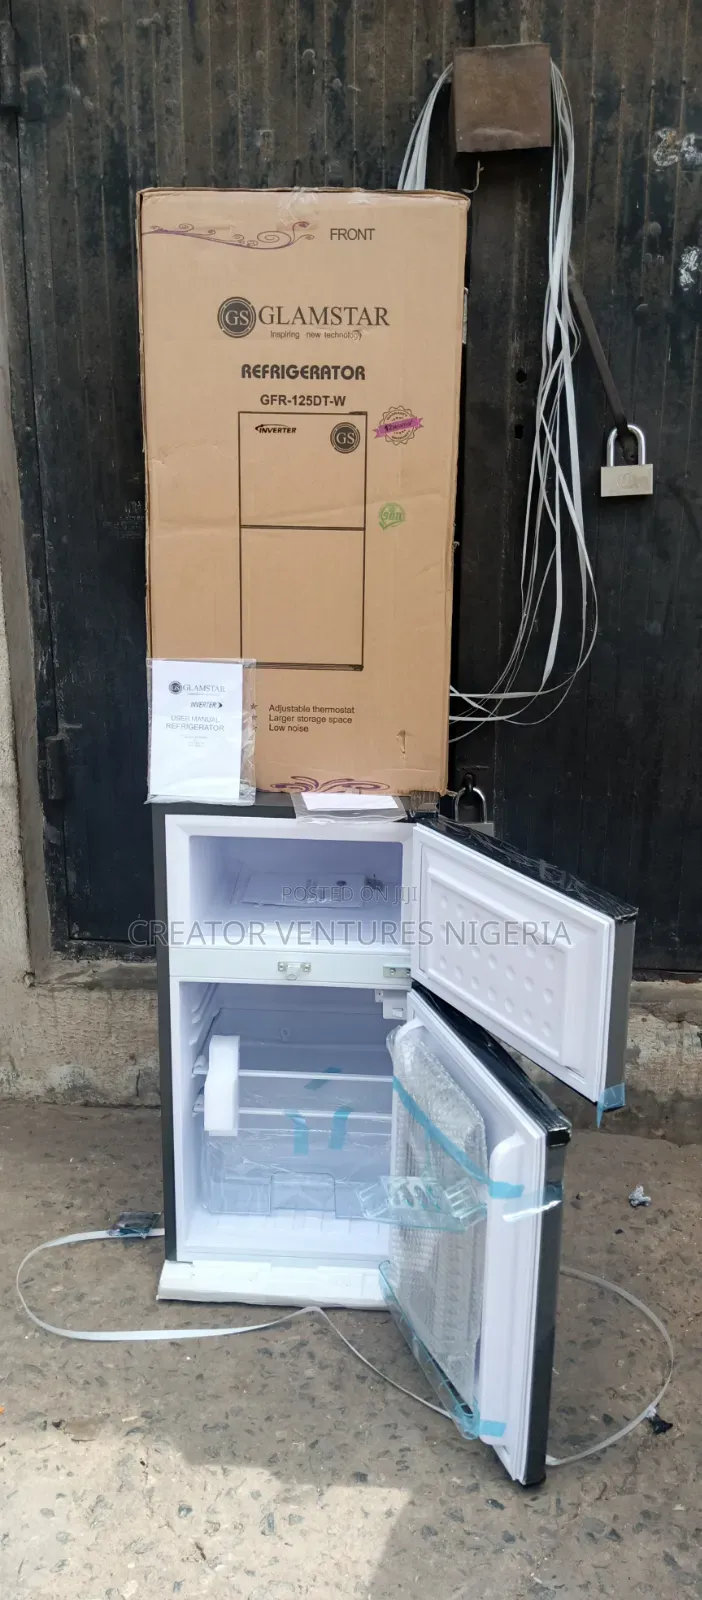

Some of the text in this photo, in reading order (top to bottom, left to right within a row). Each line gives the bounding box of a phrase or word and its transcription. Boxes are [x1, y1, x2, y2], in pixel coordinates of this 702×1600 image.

[330, 228, 375, 241] FRONT
[225, 305, 390, 326] GS GLAMSTAR
[270, 330, 300, 340] Inspiring
[241, 364, 366, 381] REFRIGERATOR
[260, 394, 346, 407] GFR-125DT-W
[257, 426, 297, 434] INVERTER
[335, 430, 356, 445] GS
[182, 684, 226, 693] GLAMSTAR
[190, 701, 217, 709] INVERTER
[269, 704, 355, 714] Adjustable thermostat
[269, 714, 353, 725] Larger storage space
[165, 723, 225, 732] REFRIGERATOR
[269, 724, 309, 733] Low noise
